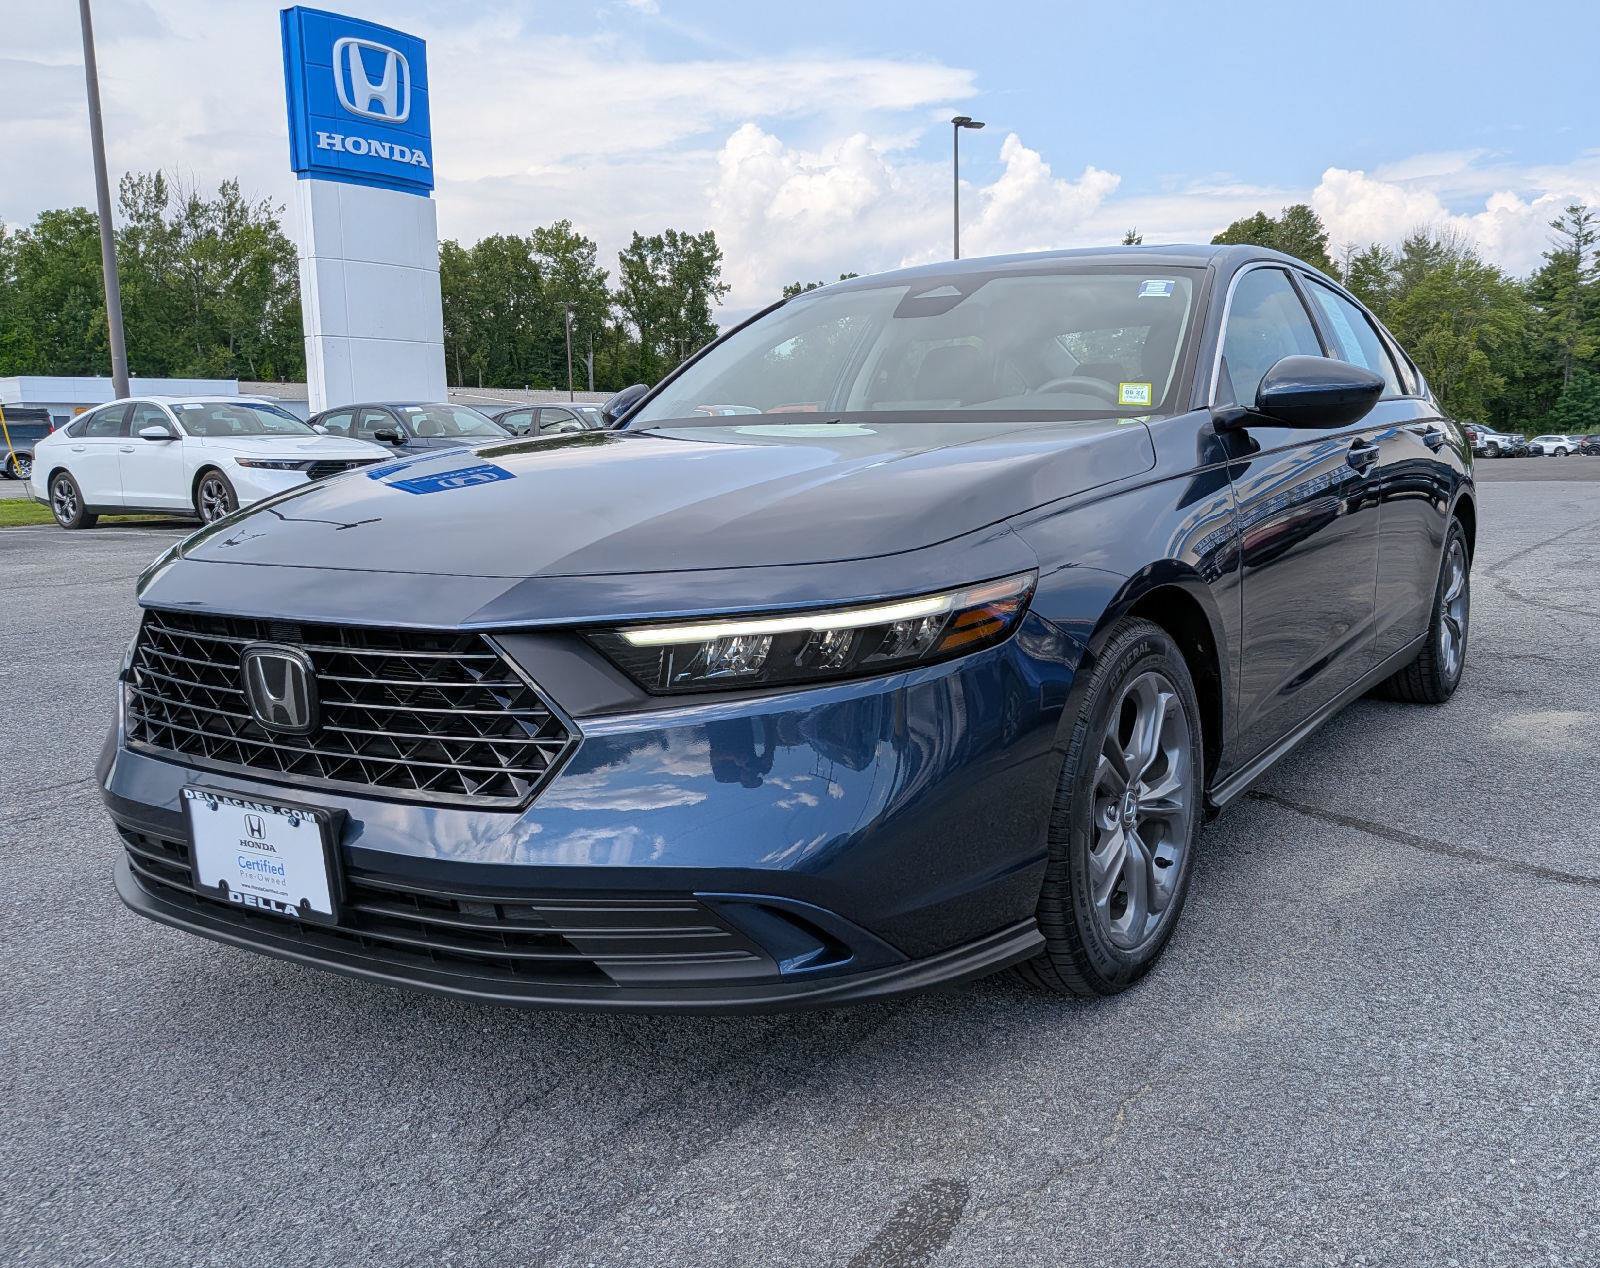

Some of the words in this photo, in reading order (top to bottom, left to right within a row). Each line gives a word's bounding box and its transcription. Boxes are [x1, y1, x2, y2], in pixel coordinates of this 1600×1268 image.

[316, 131, 430, 169] HONDA
[183, 788, 316, 823] DELLACARS.COM
[239, 839, 277, 853] HONDA
[238, 855, 285, 876] Certified
[240, 869, 287, 887] Pre-Owned
[228, 890, 300, 917] DELLA
